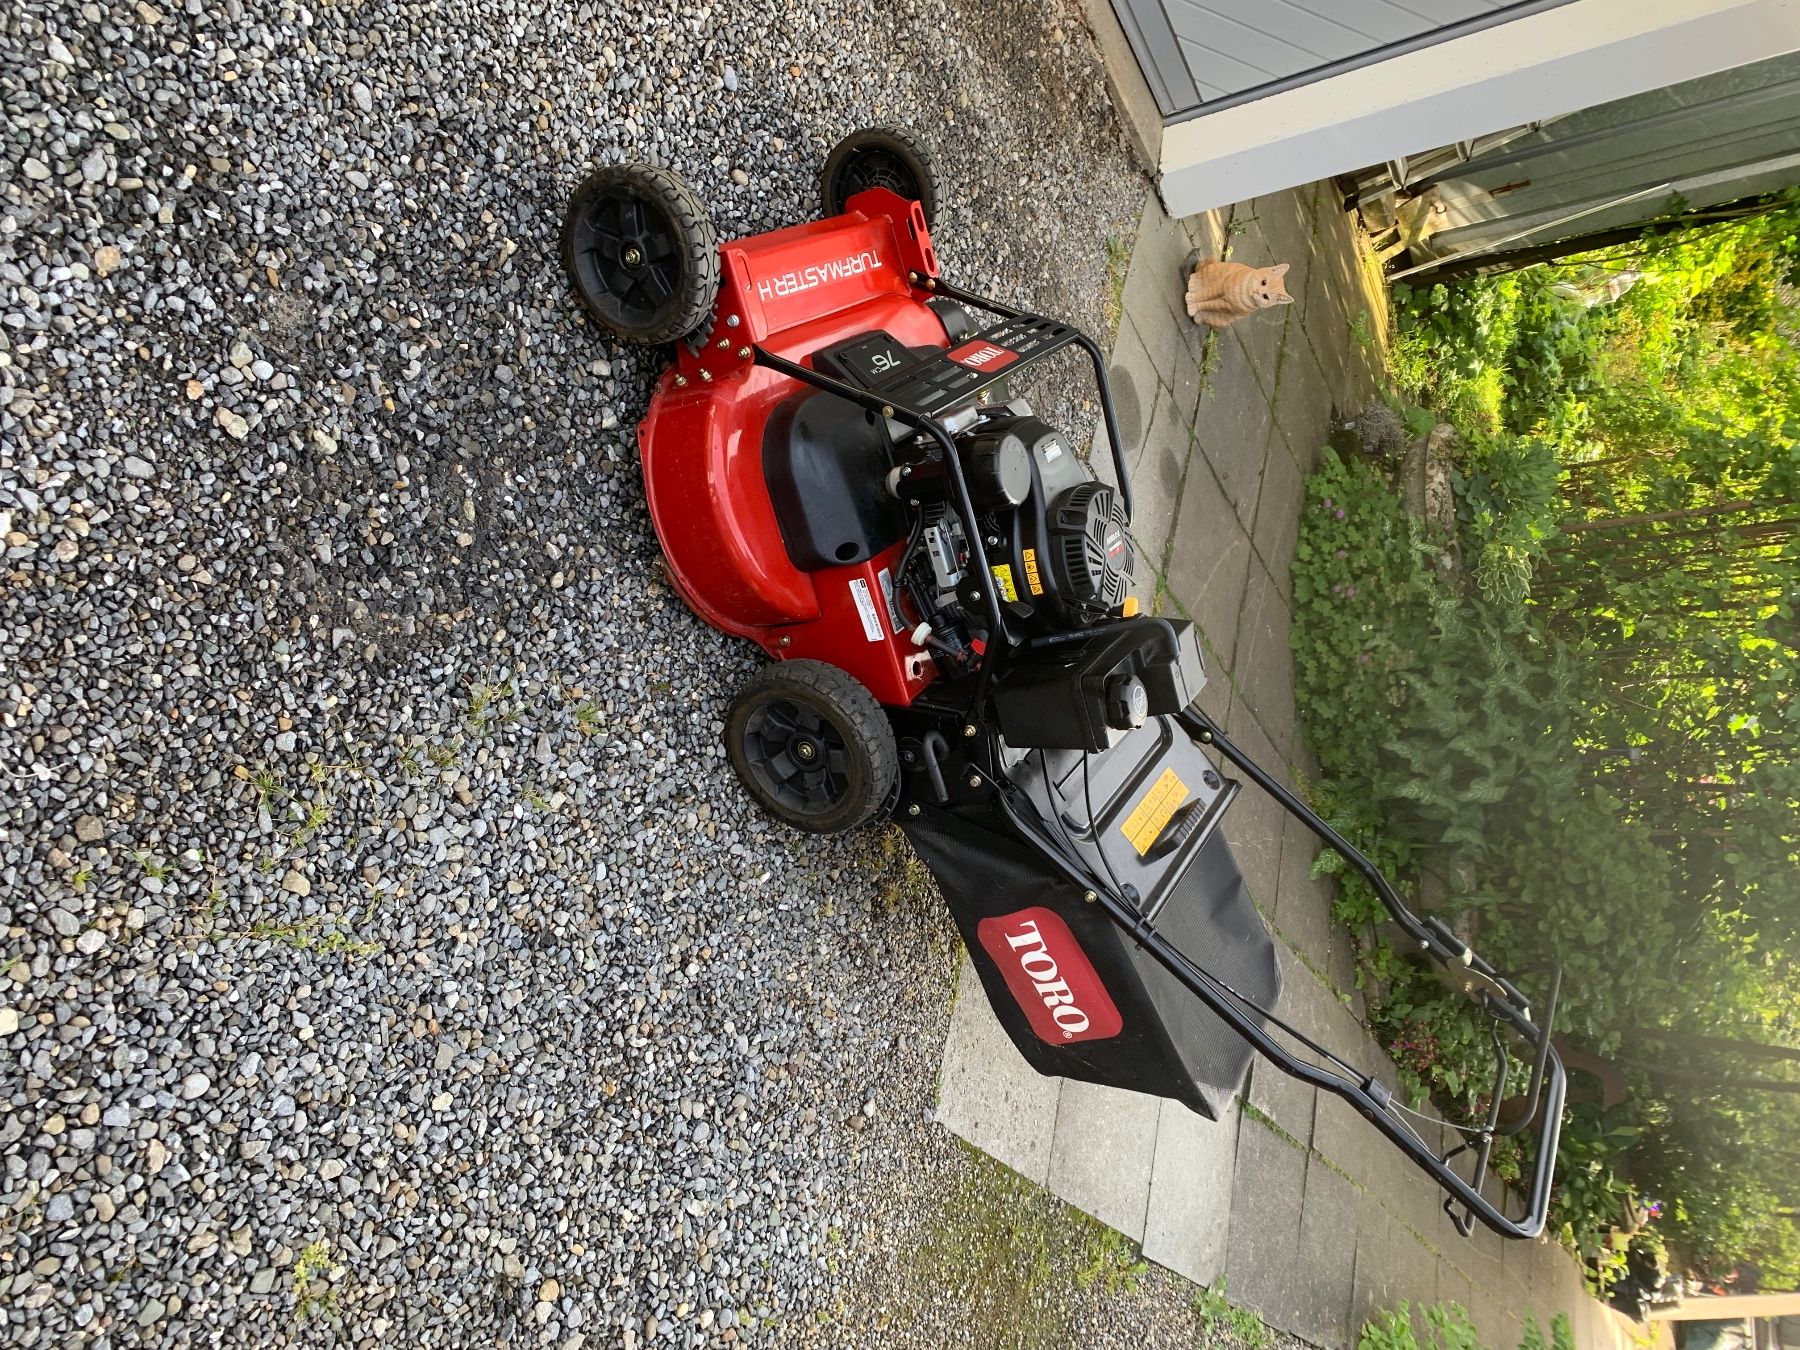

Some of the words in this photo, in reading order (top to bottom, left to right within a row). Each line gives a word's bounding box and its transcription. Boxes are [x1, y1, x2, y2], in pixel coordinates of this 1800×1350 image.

[774, 249, 882, 297] TURFMASTER
[757, 280, 773, 302] H
[871, 350, 901, 371] 76
[963, 346, 1005, 366] TORO
[1004, 919, 1090, 1034] TORO
